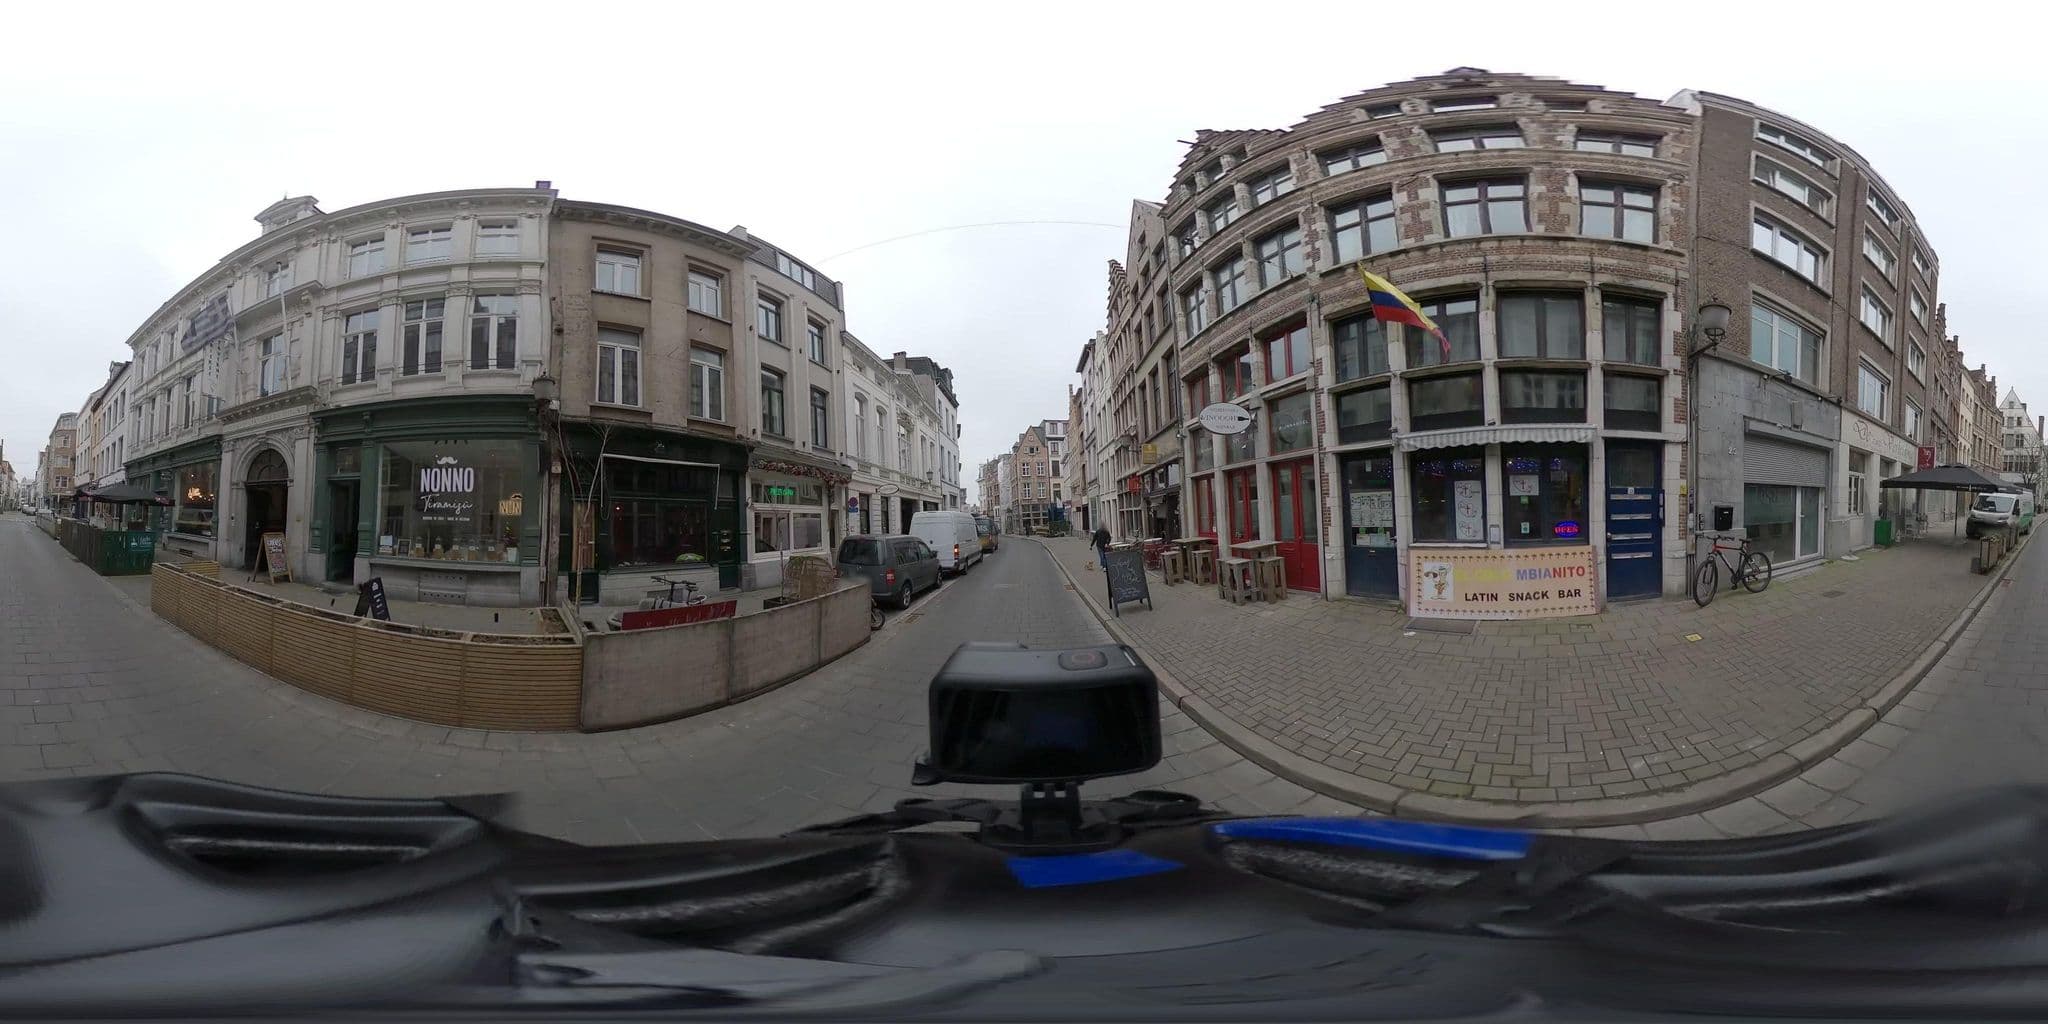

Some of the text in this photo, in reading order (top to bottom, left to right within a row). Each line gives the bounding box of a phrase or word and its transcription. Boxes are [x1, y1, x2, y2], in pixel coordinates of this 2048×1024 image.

[420, 467, 474, 492] NONNO
[1464, 588, 1581, 602] LATIN SNACK BAR
